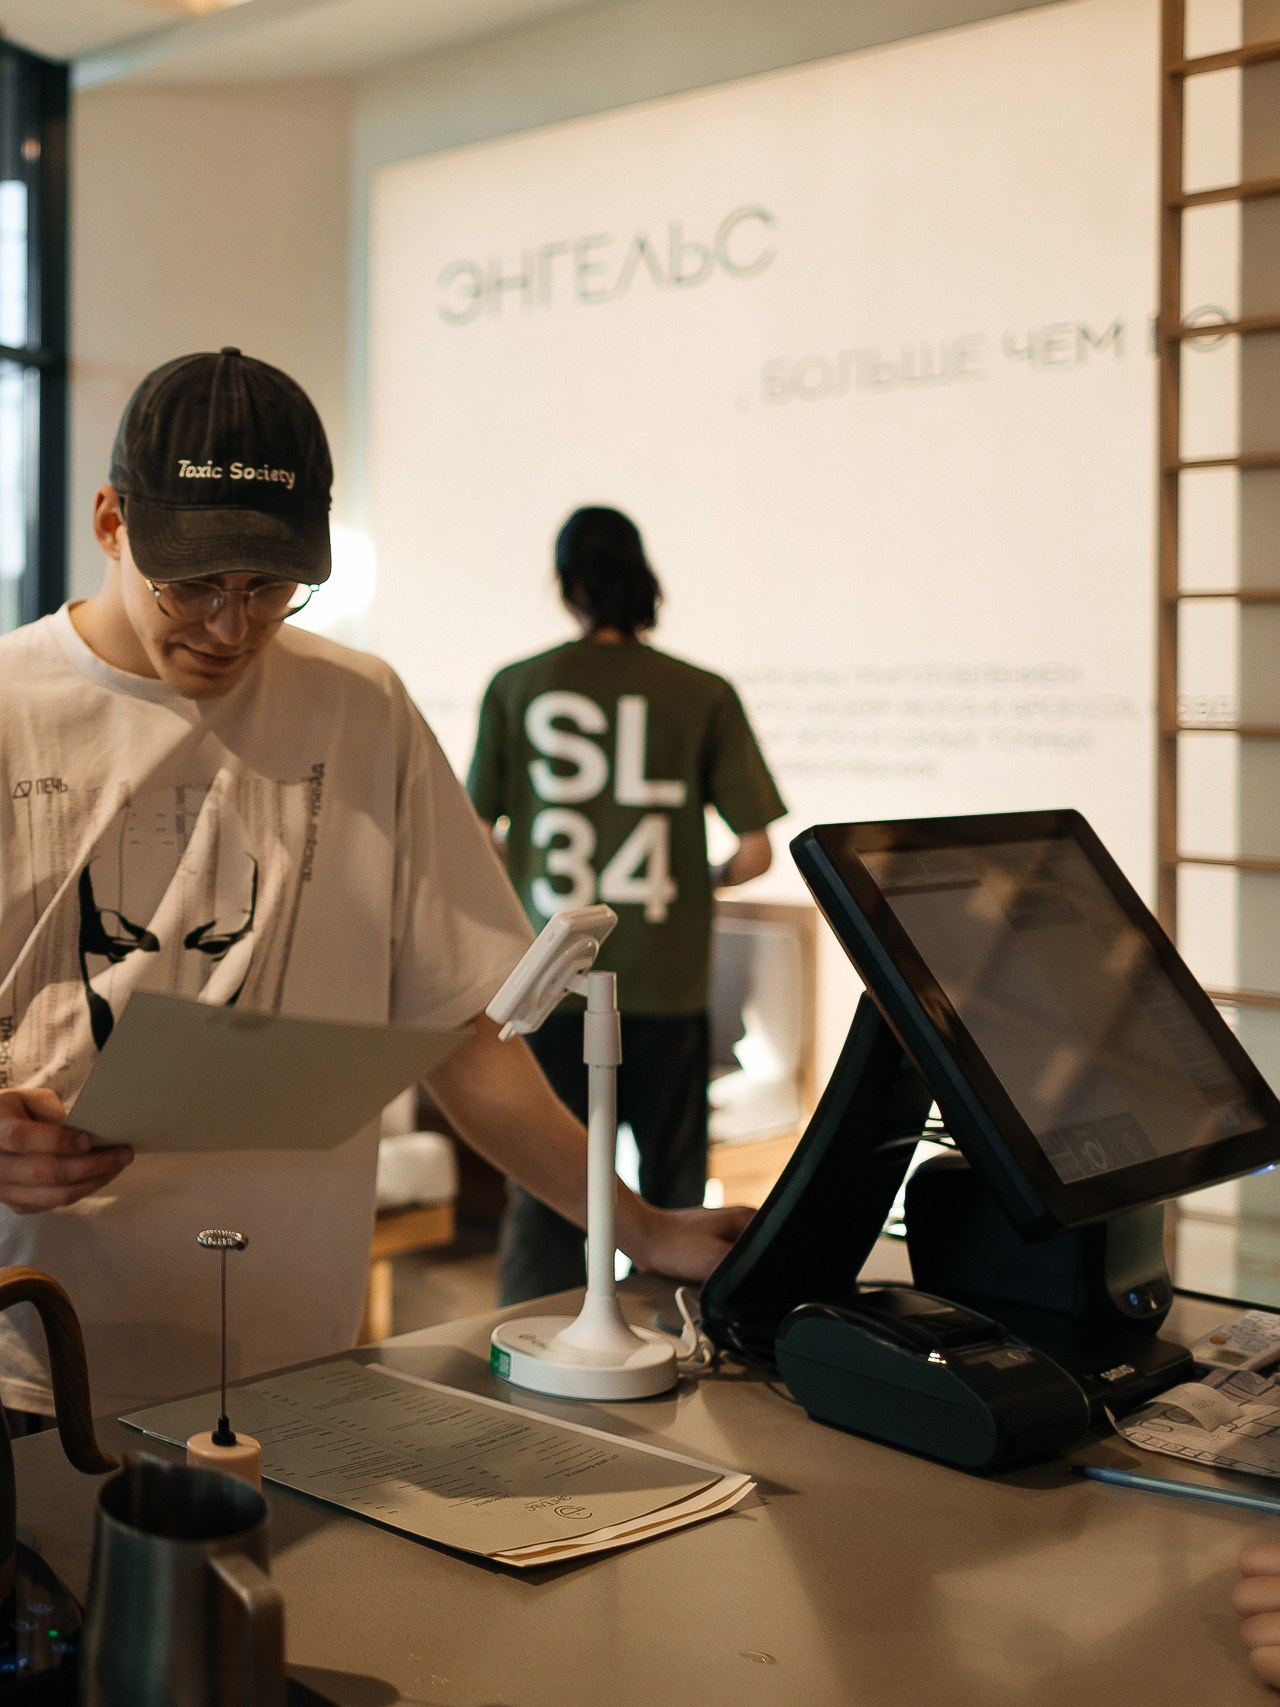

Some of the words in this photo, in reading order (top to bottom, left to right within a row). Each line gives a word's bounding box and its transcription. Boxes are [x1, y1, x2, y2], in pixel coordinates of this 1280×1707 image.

[435, 203, 776, 327] ЭНГЕЛЬС
[760, 333, 987, 405] БОЛЬШЕ
[1002, 316, 1125, 374] ЧЕМ
[178, 459, 223, 479] Toxic
[229, 462, 296, 490] Society
[524, 690, 687, 809] SL
[531, 806, 678, 923] 34
